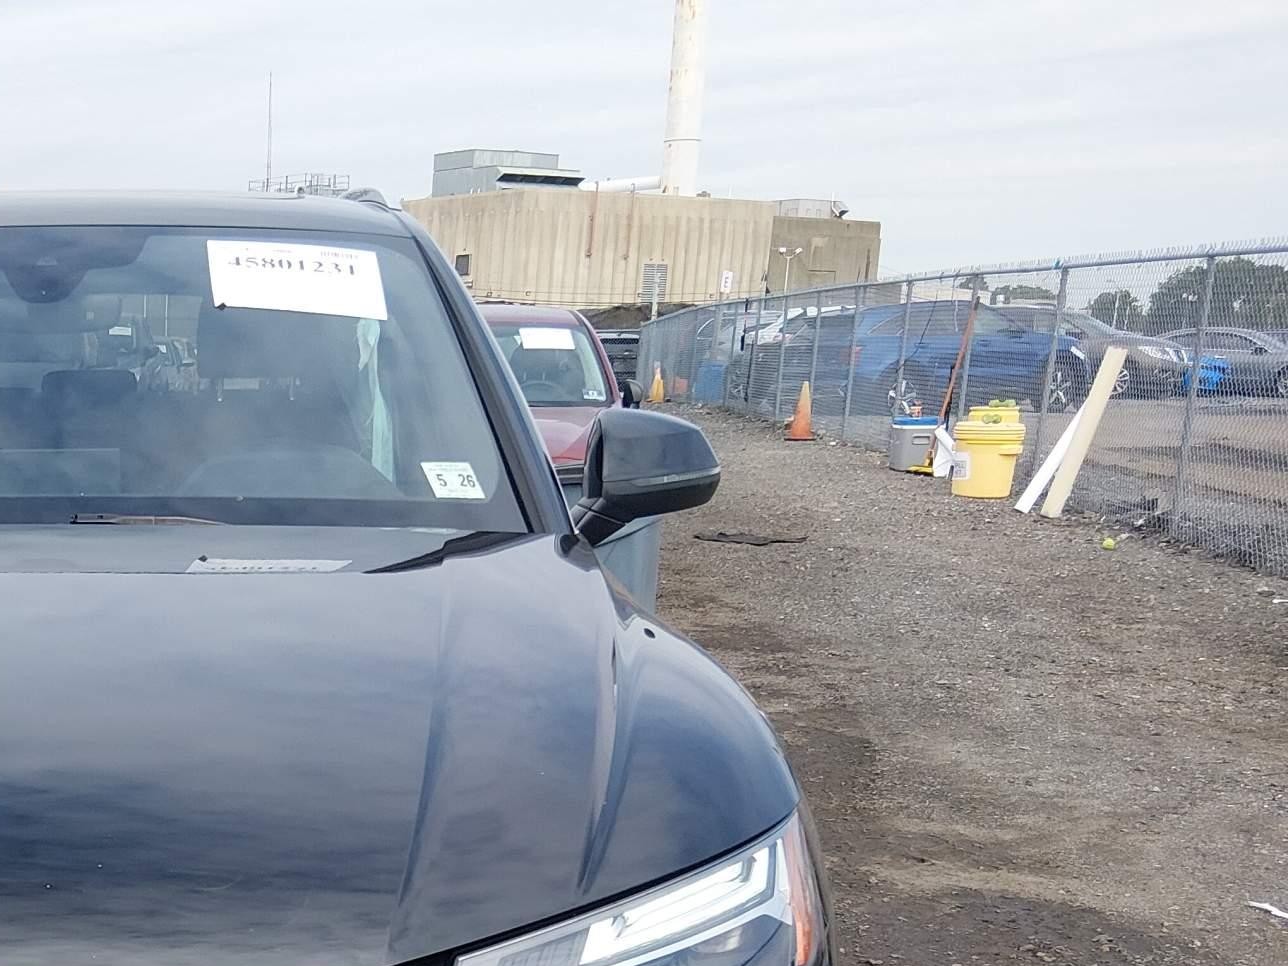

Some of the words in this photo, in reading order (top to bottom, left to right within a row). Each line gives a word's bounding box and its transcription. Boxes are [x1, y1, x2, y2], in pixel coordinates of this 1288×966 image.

[228, 256, 355, 276] 45801231
[435, 473, 448, 487] 5
[458, 473, 476, 488] 26
